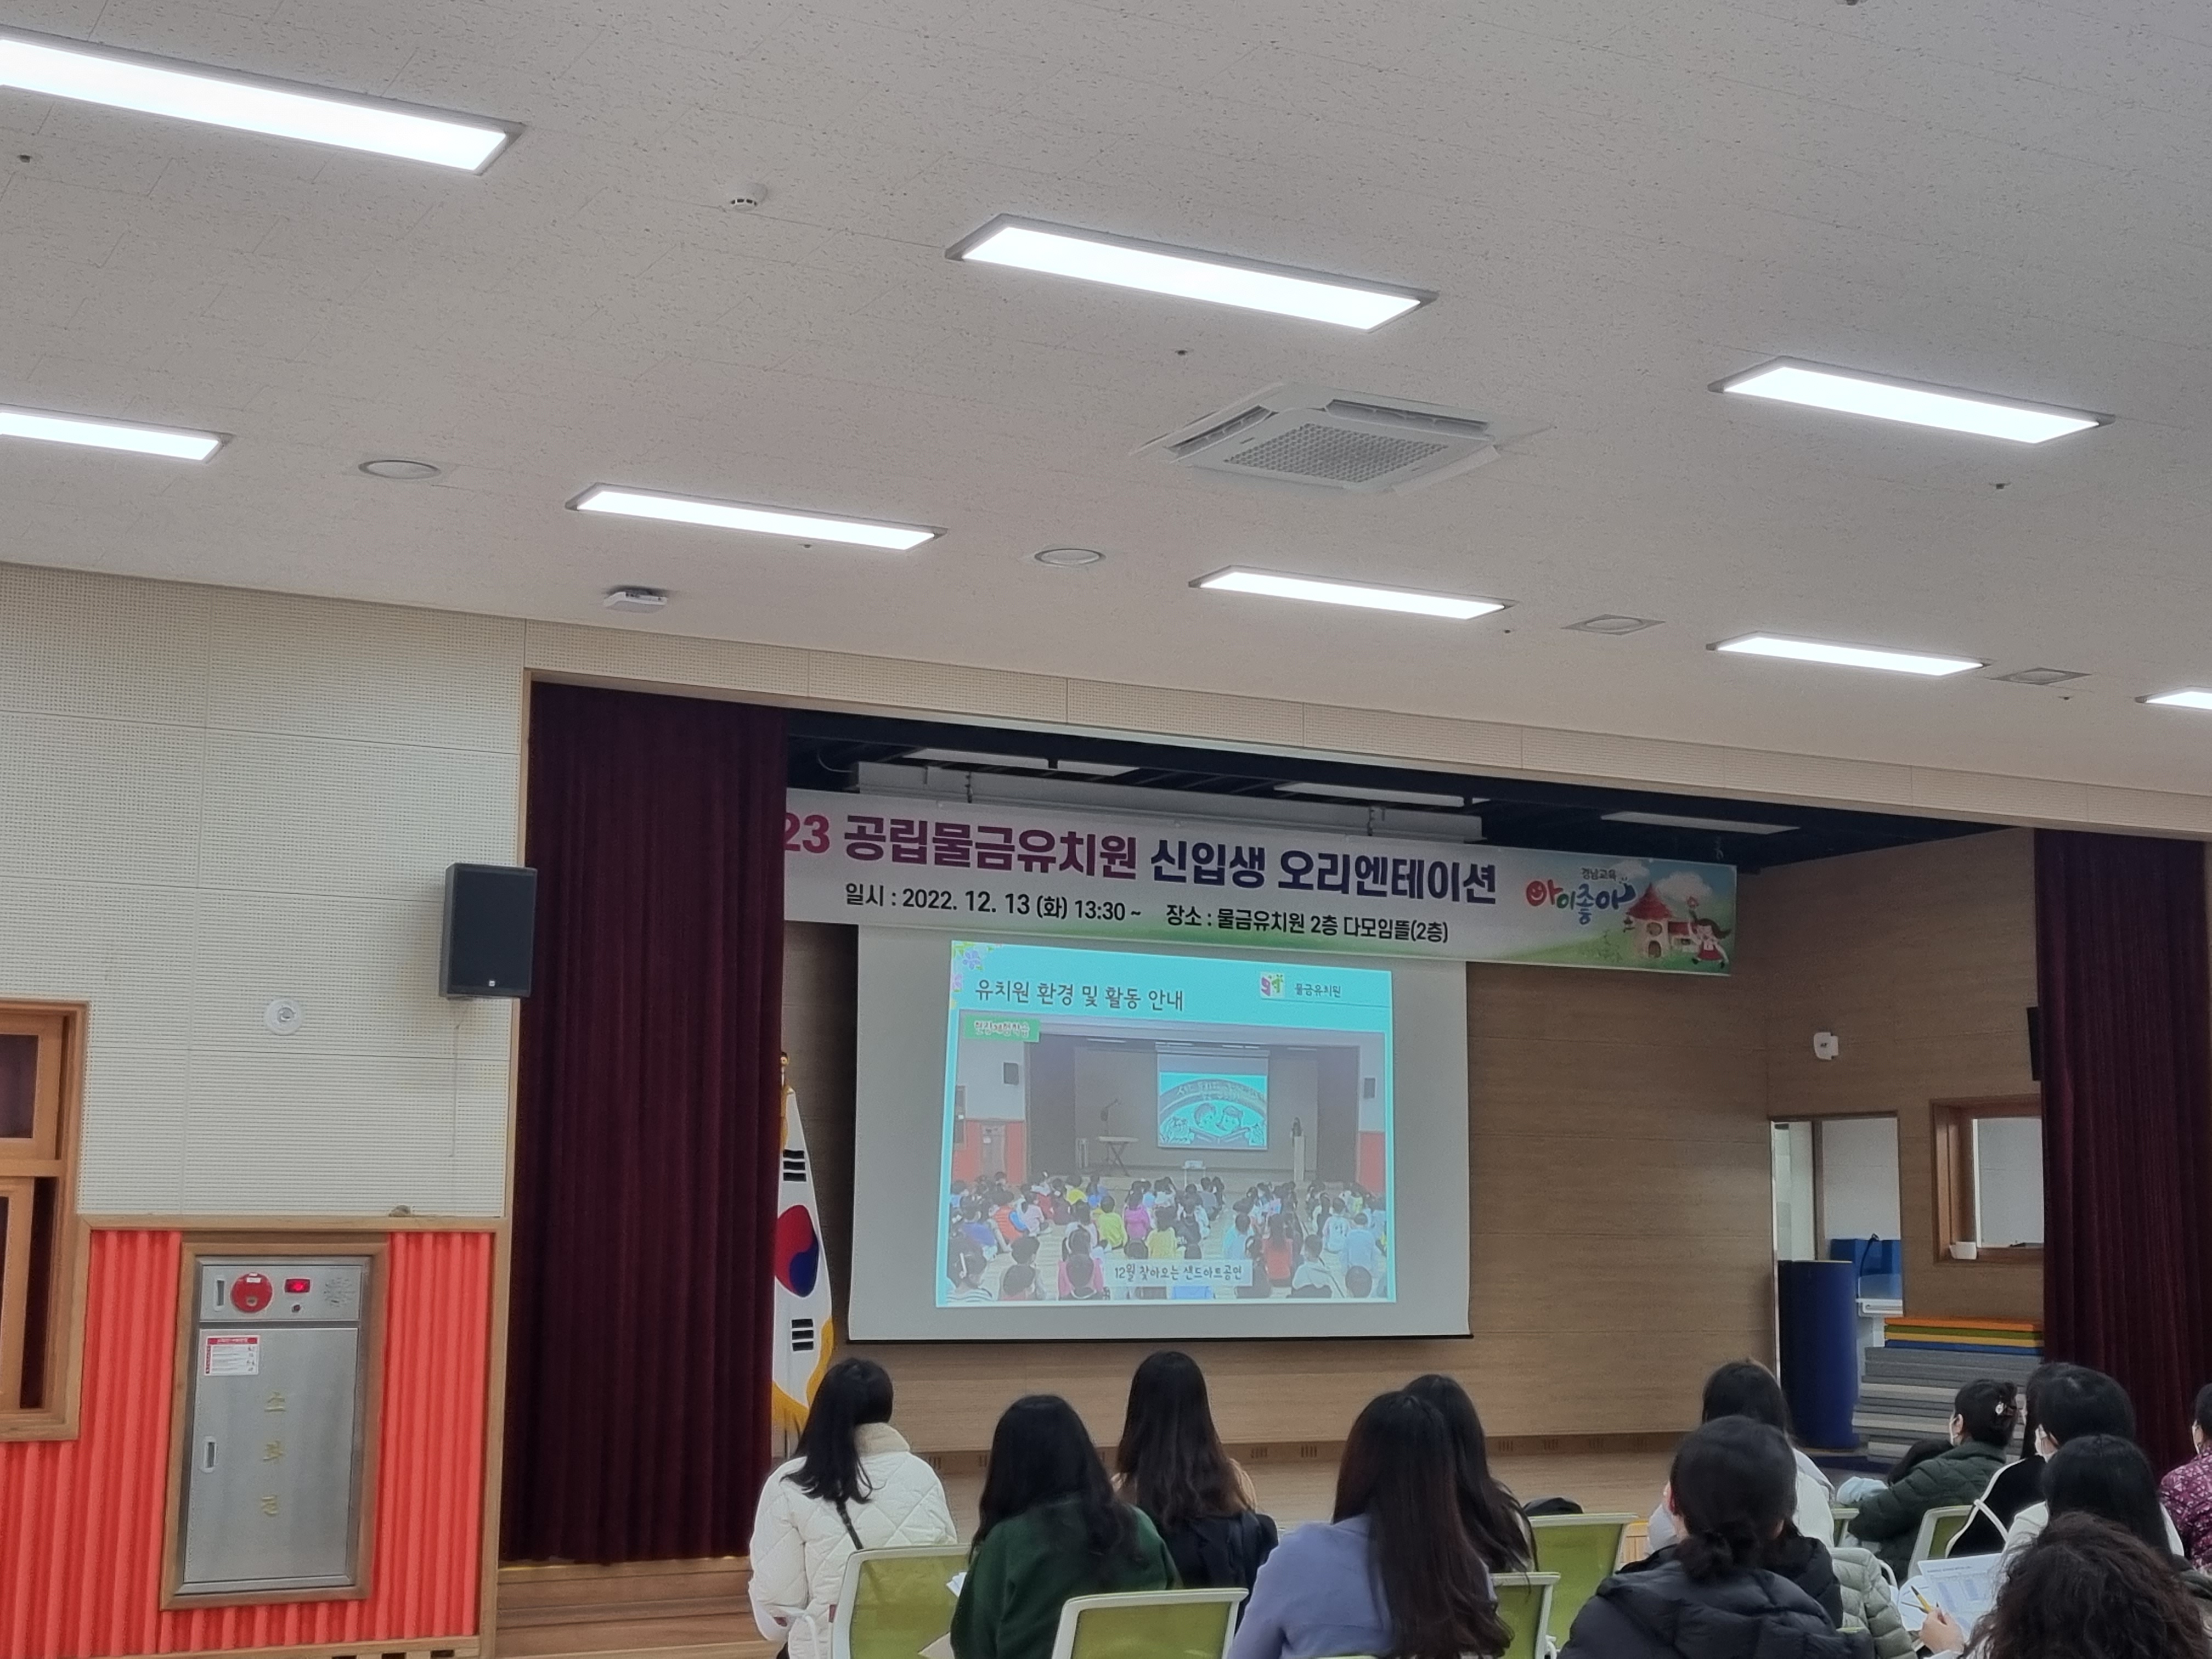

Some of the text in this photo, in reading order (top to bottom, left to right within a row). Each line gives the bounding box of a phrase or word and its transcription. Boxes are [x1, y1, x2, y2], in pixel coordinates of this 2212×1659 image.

[786, 812, 1496, 904] 23 공립물금유치원 신입생 오리엔테이션
[1582, 867, 1617, 881] 경남교육
[845, 883, 884, 906] 일시
[902, 888, 957, 911] 2022.
[965, 890, 996, 912] 12.
[1005, 893, 1030, 915] 13
[1036, 895, 1068, 919] (화)
[1075, 900, 1126, 921] 13:30
[1526, 878, 1637, 925] 아이좋아
[1166, 905, 1202, 926] 장소
[1217, 908, 1305, 934] 물금유치원
[1310, 915, 1338, 936] 2층
[1344, 917, 1448, 943] 다모임뜰(2층)
[975, 979, 1184, 1012] 유치원 환경 및 활동 안내
[1295, 983, 1342, 998] 물금유치원
[1114, 1263, 1242, 1282] 12월 찾아오는 샌드아트공연
